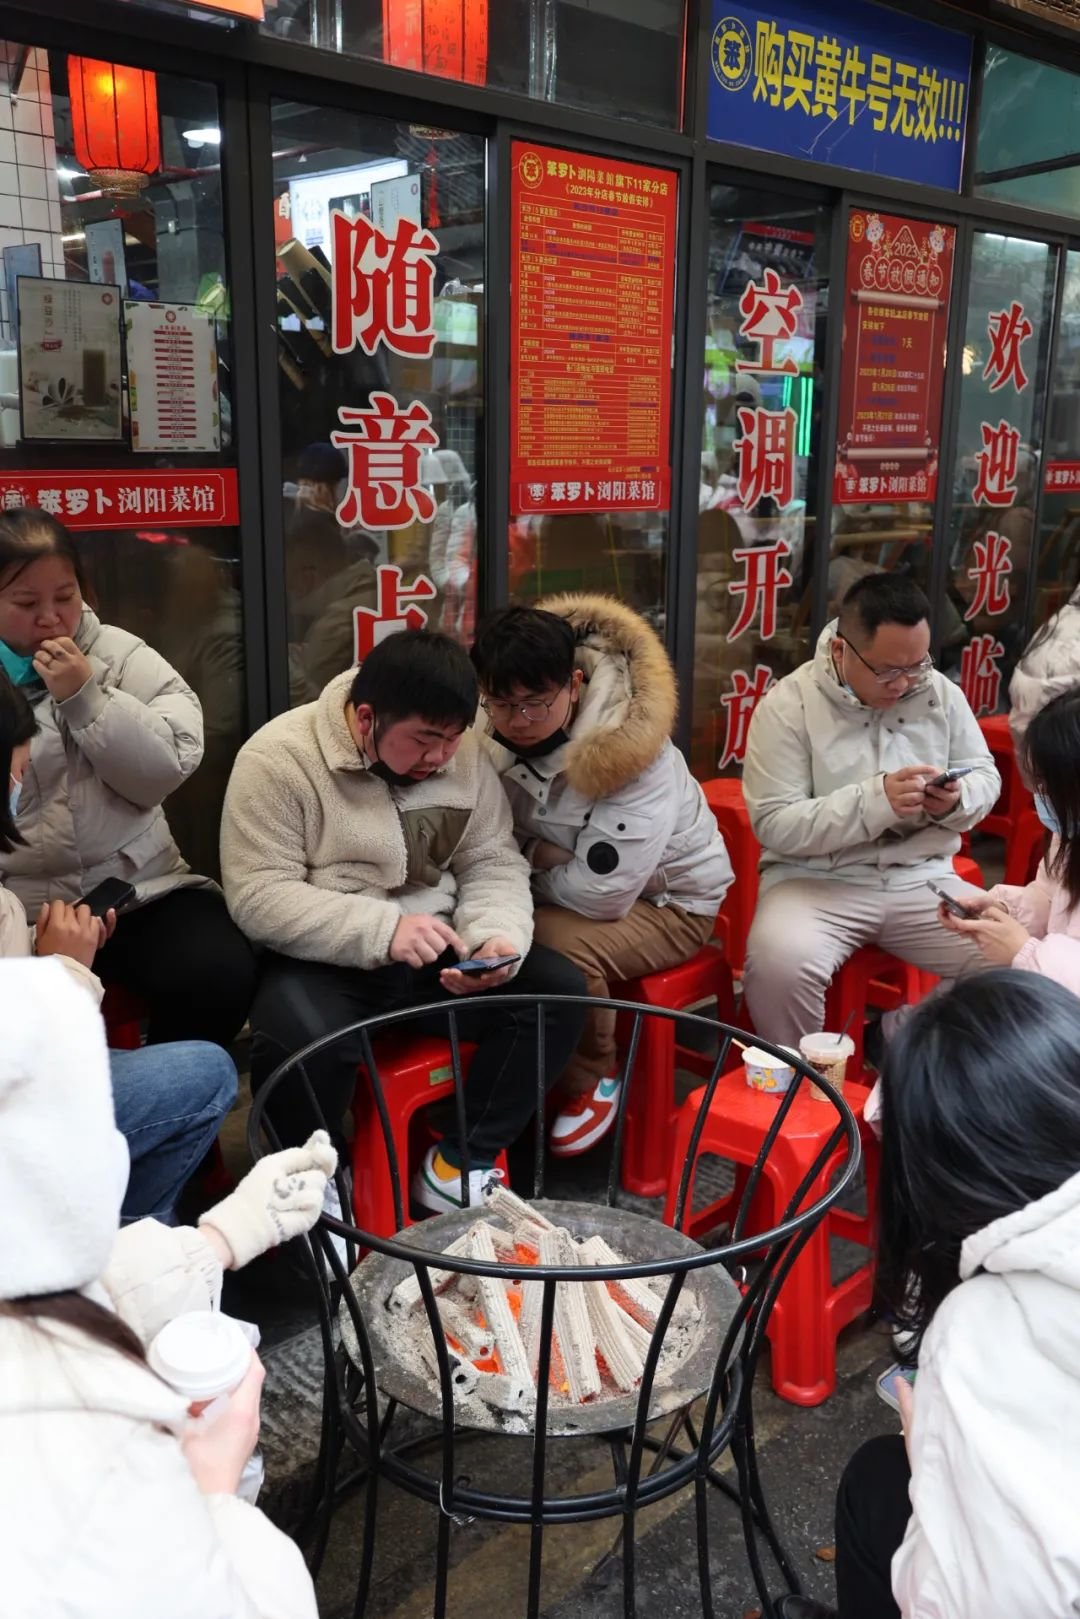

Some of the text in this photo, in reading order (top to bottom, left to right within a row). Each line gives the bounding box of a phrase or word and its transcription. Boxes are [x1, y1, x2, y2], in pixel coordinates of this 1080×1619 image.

[894, 243, 918, 258] 2023
[862, 262, 940, 289] 春节放假通知
[37, 485, 215, 515] 笨罗卜浏阳菜馆
[551, 480, 656, 502] 笨罗卜浏阳菜馆
[960, 300, 1033, 717] 欢迎光临
